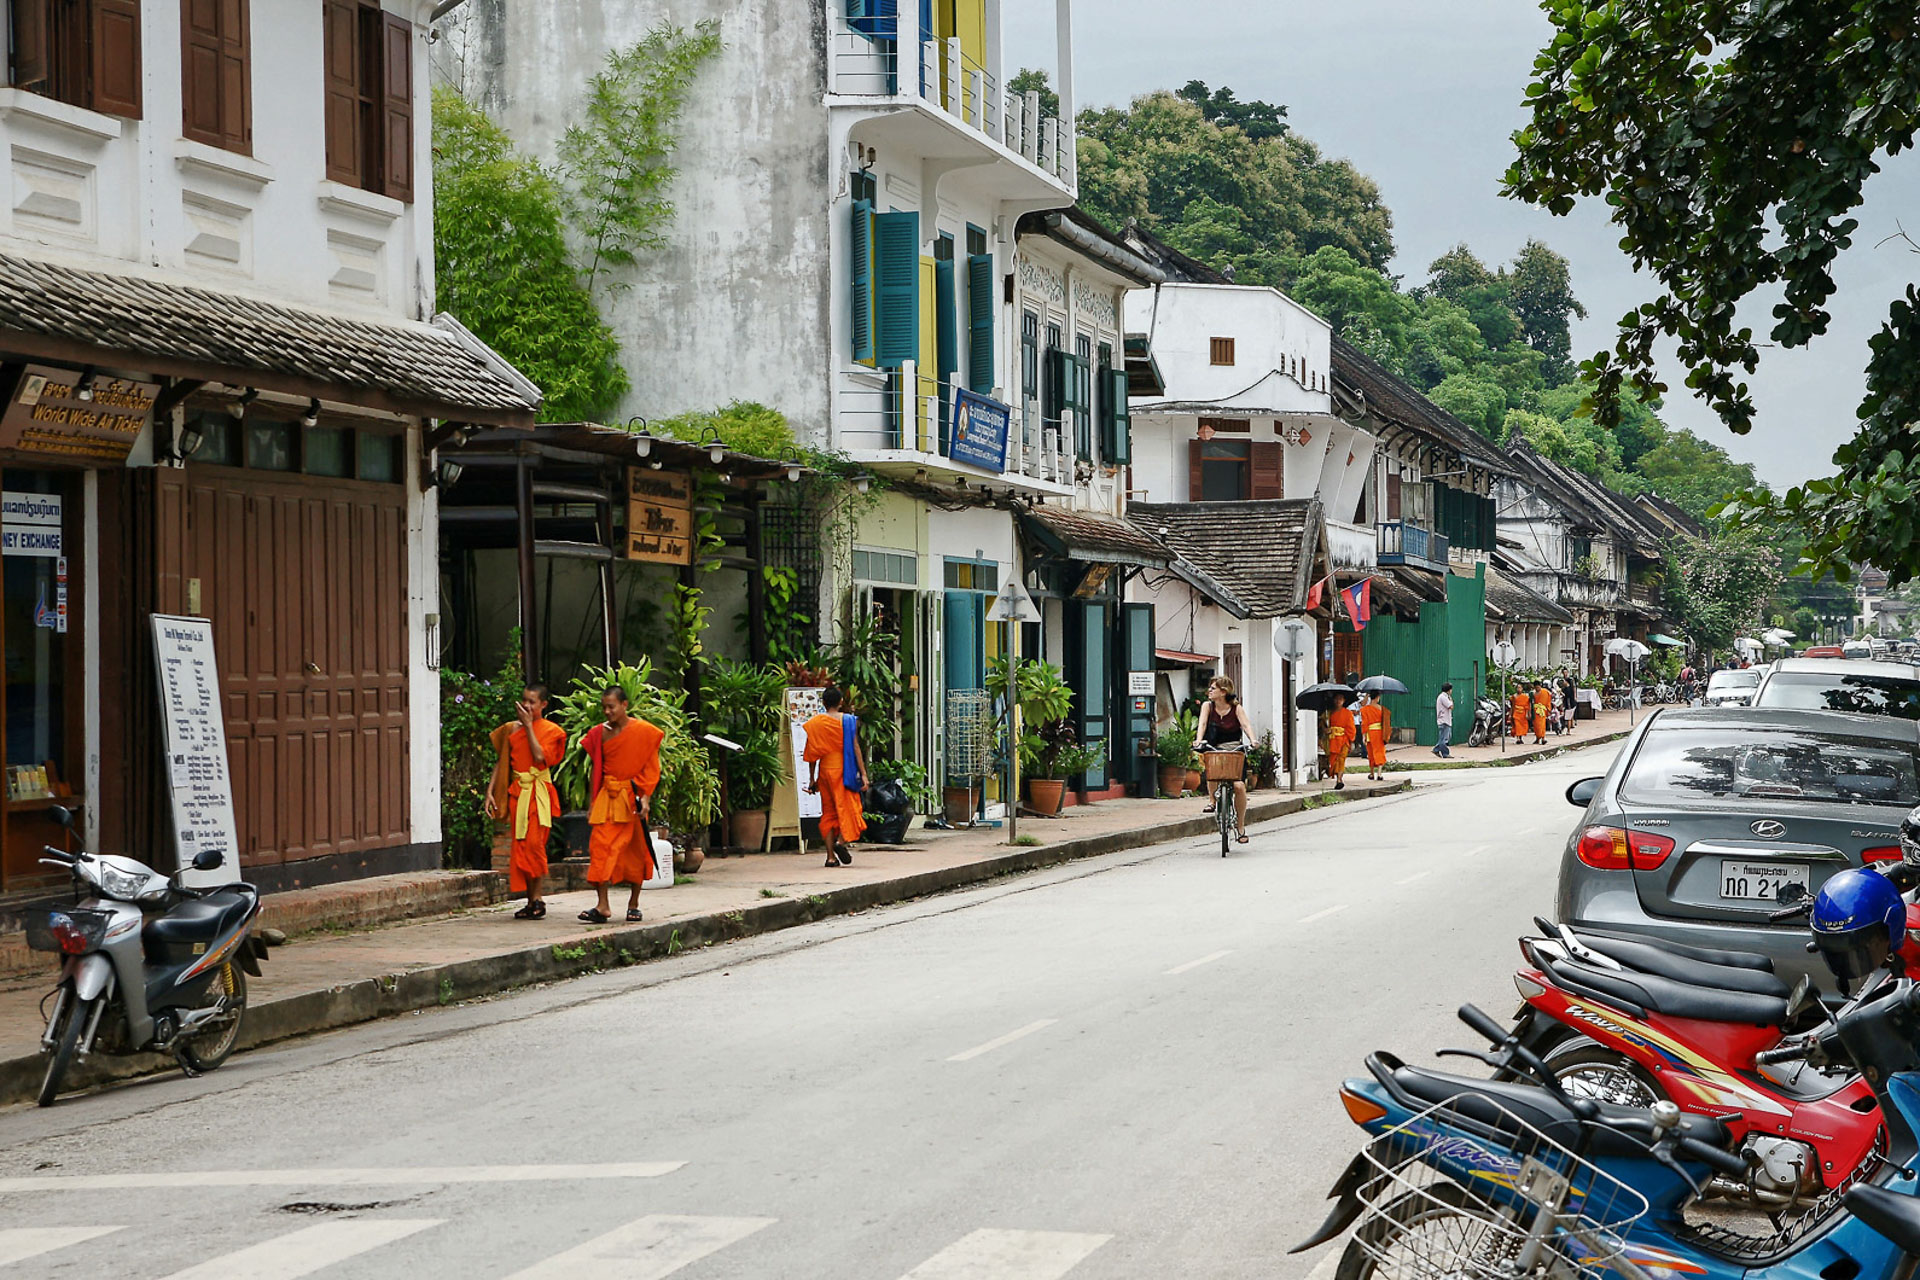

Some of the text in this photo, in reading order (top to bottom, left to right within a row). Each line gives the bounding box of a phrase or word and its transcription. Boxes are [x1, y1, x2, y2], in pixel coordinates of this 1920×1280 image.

[33, 403, 145, 433] World Wide Air Ticket
[21, 532, 60, 550] EXCHANGE
[1633, 819, 1670, 827] HYUNDAI
[1850, 830, 1900, 840] ELANTR
[1758, 879, 1804, 898] 21
[1440, 1156, 1467, 1172] HONDA
